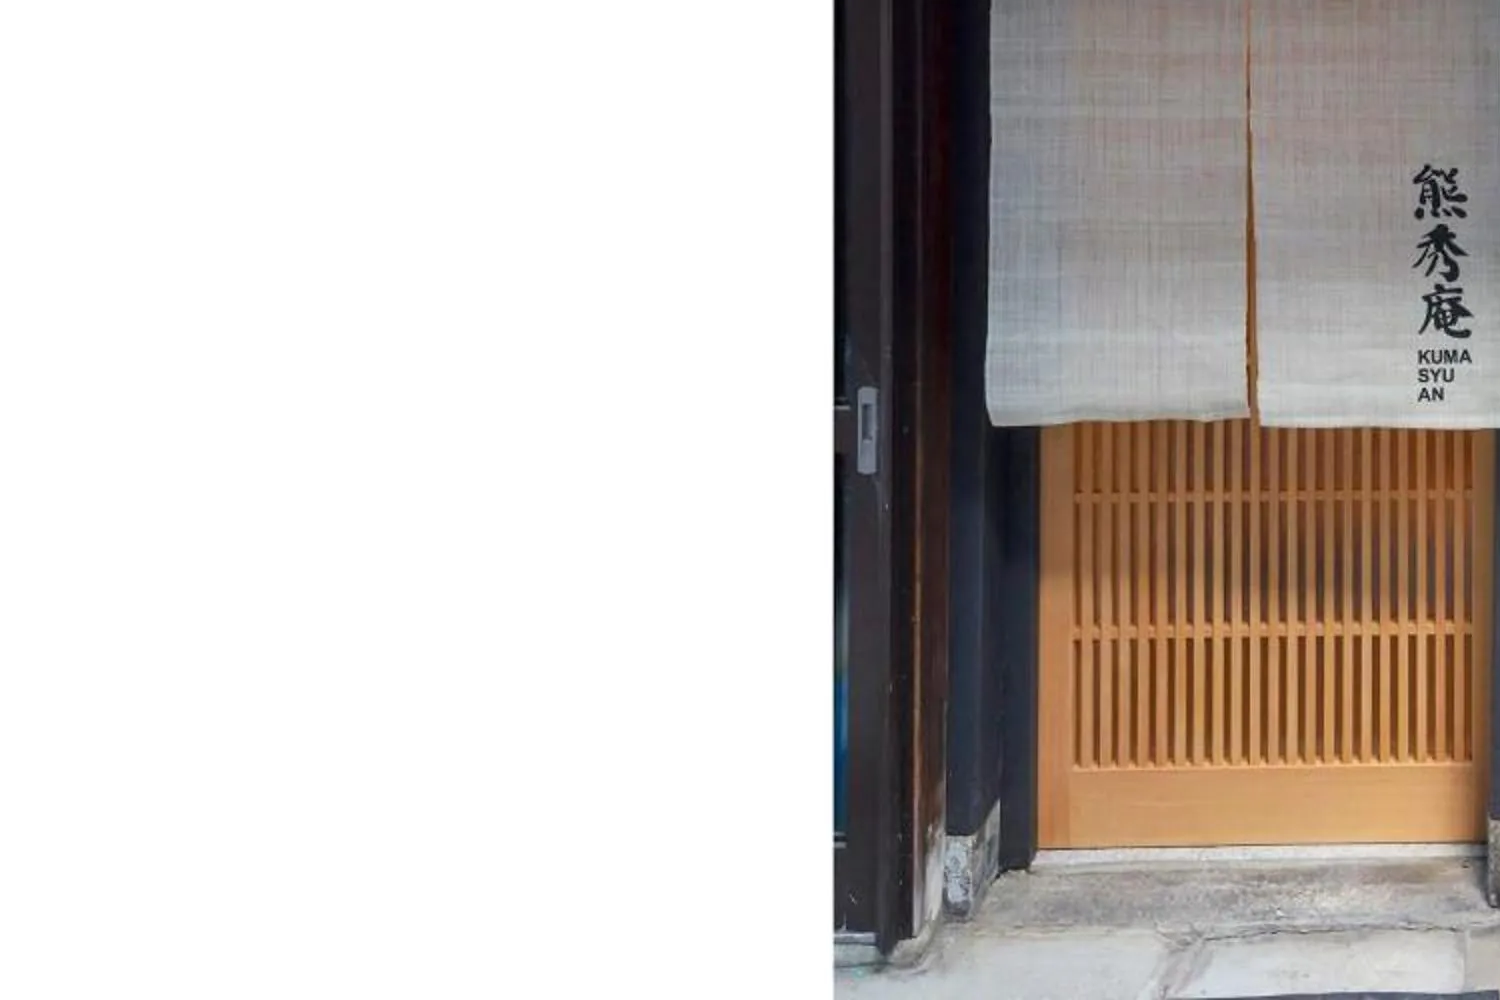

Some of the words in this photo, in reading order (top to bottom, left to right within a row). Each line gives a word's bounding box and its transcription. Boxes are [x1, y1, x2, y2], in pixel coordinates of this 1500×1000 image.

[1412, 163, 1474, 338] 熊秀庵
[1418, 350, 1472, 365] KUMA
[1418, 368, 1455, 383] SYU
[1417, 387, 1445, 401] AN
